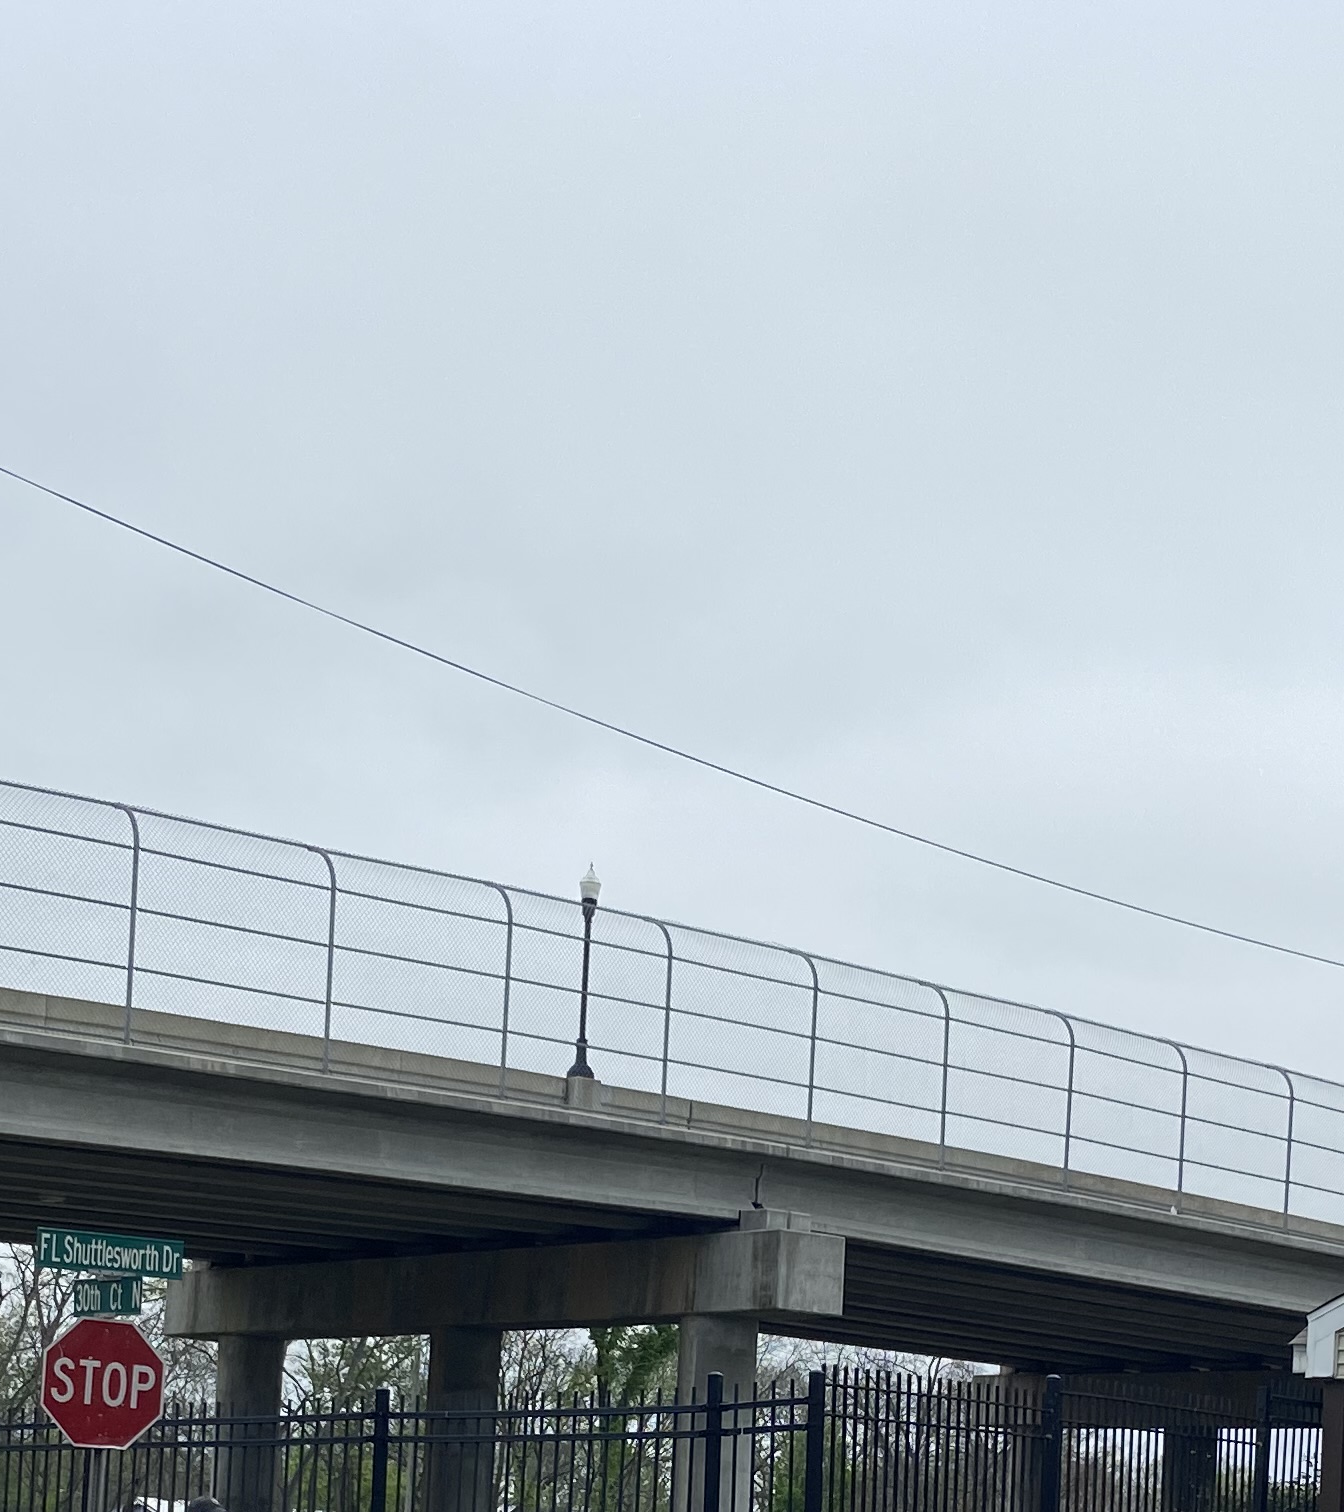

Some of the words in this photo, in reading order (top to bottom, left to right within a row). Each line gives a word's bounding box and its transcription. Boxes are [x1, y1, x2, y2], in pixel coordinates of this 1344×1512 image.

[63, 1235, 159, 1272] Shuttlesworth
[162, 1245, 180, 1273] Dr
[76, 1283, 101, 1311] 30th
[110, 1283, 122, 1310] Ct
[131, 1280, 141, 1309] N
[50, 1357, 156, 1409] STOP
